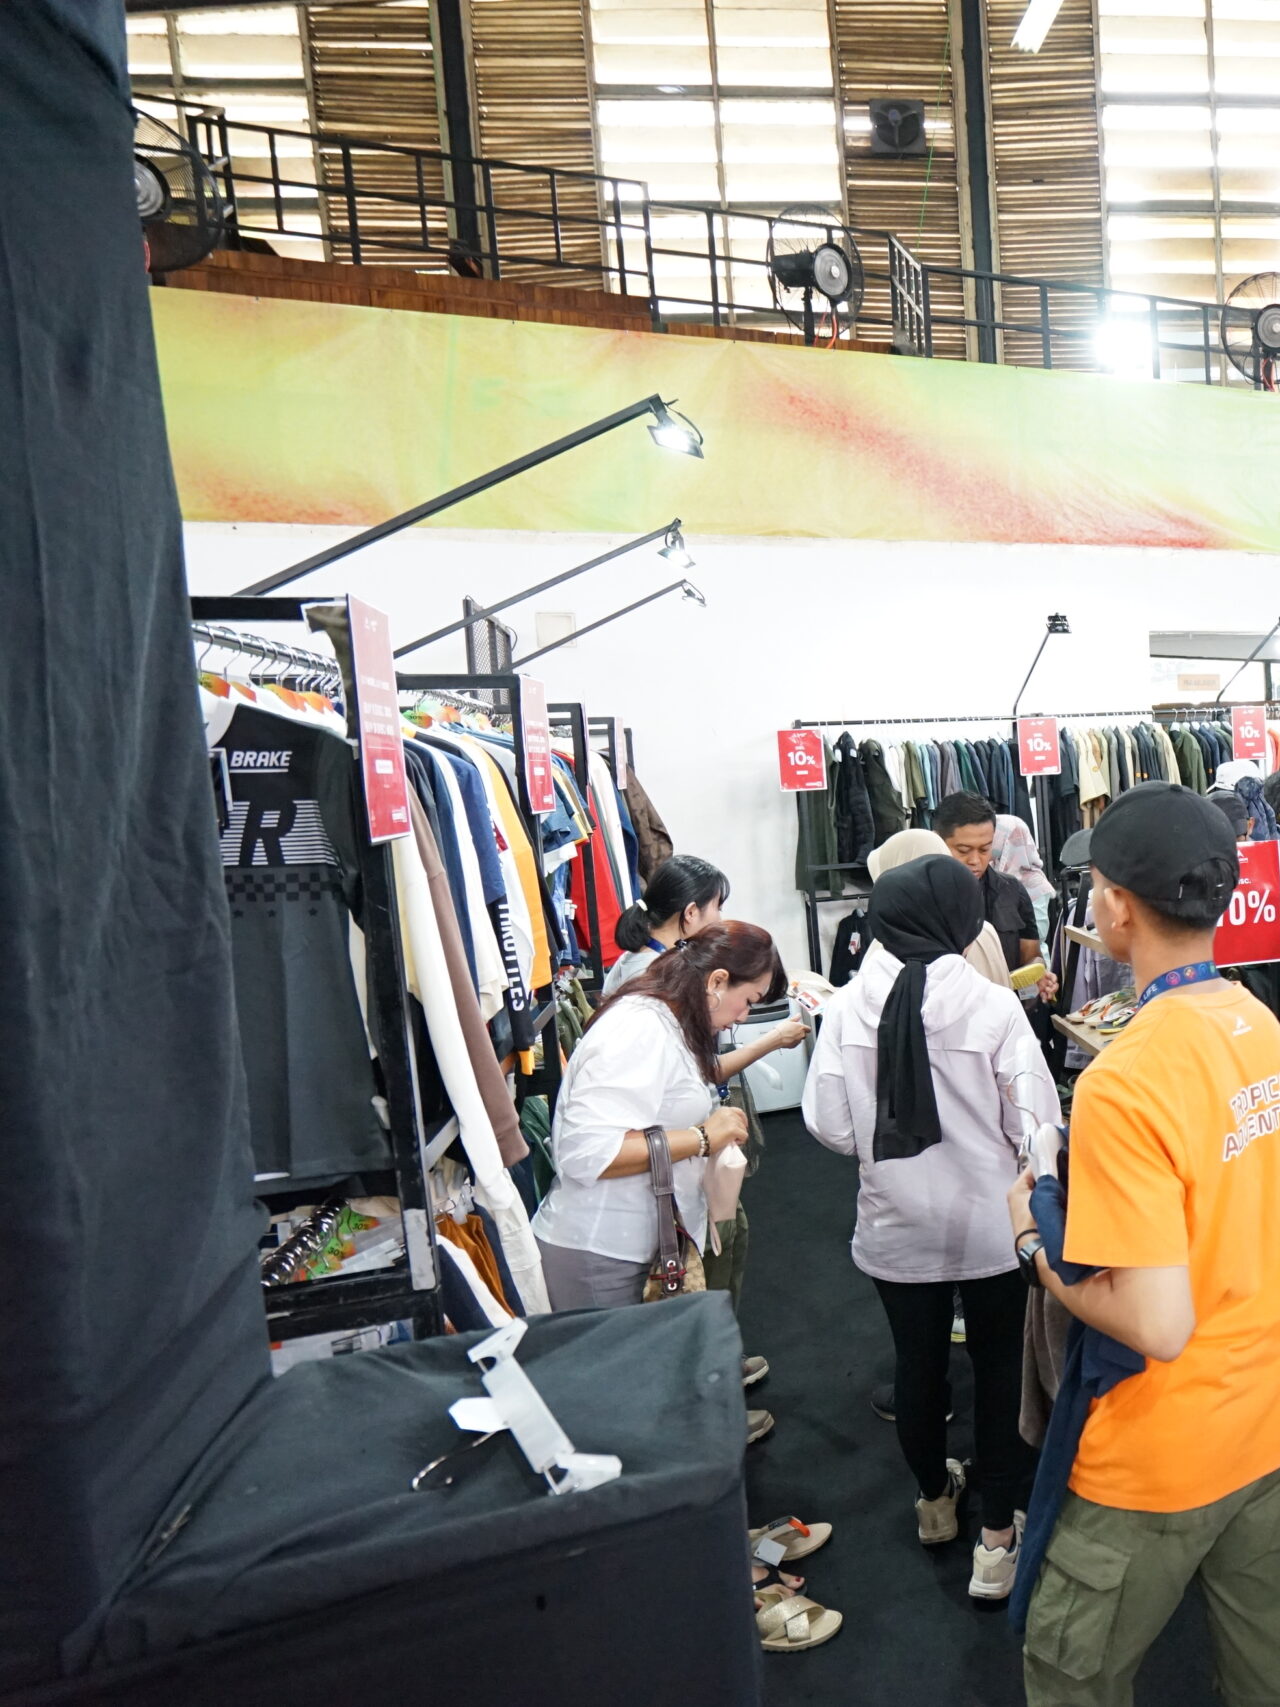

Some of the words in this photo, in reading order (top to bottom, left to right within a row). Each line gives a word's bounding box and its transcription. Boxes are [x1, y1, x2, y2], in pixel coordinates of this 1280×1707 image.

[1239, 725, 1261, 739] 10%
[1027, 737, 1052, 752] 10%
[230, 751, 293, 767] BRAKE
[787, 750, 816, 766] 10%
[1216, 888, 1276, 927] 0%
[1142, 983, 1158, 1001] LIFE
